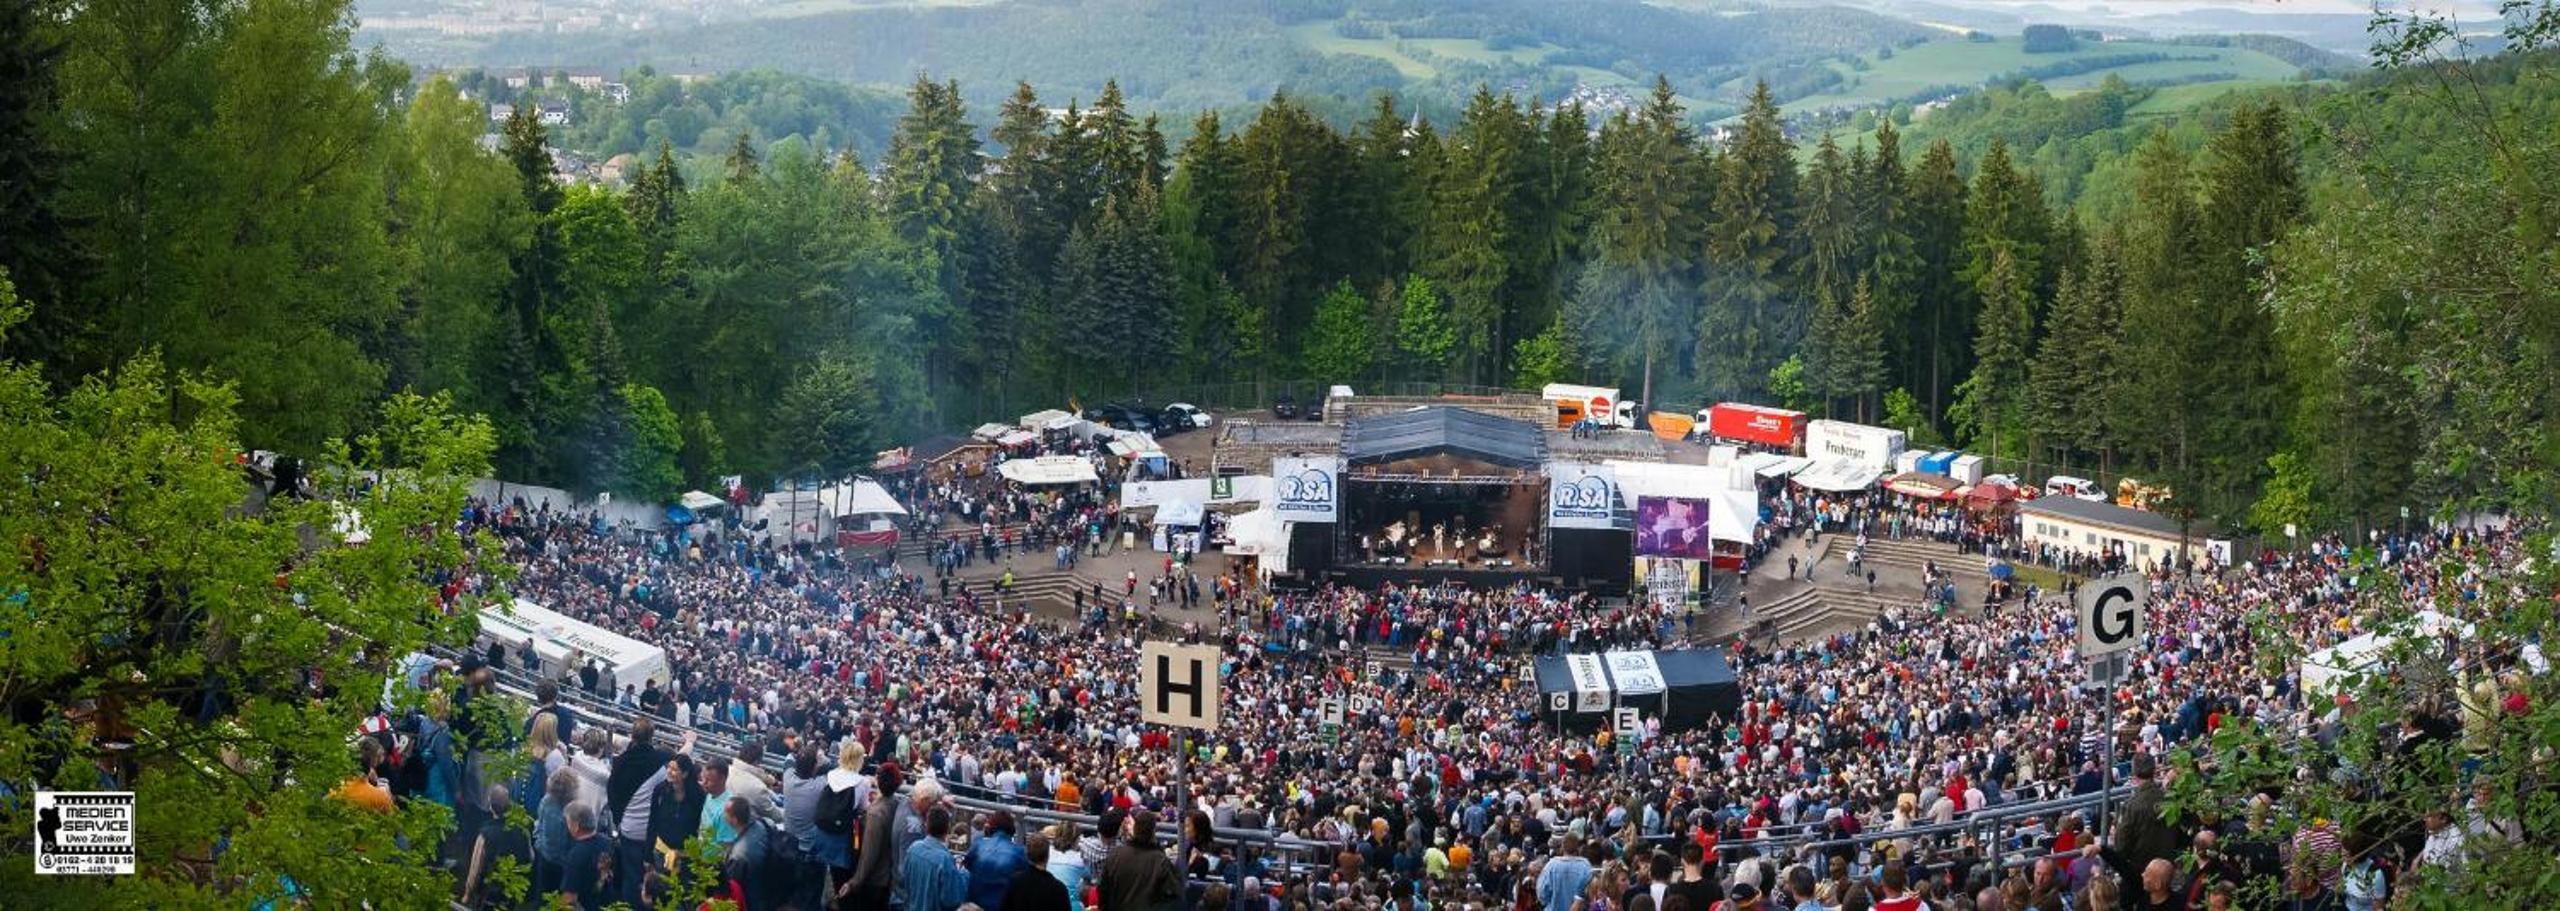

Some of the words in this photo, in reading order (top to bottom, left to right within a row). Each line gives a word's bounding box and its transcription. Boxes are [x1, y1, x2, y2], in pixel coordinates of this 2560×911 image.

[2092, 586, 2134, 644] G
[1368, 665, 1378, 674] B
[1522, 668, 1532, 679] A
[1157, 654, 1202, 718] H
[1352, 697, 1364, 711] D
[1554, 694, 1566, 708] C
[1324, 702, 1337, 720] F
[1619, 712, 1633, 730] E
